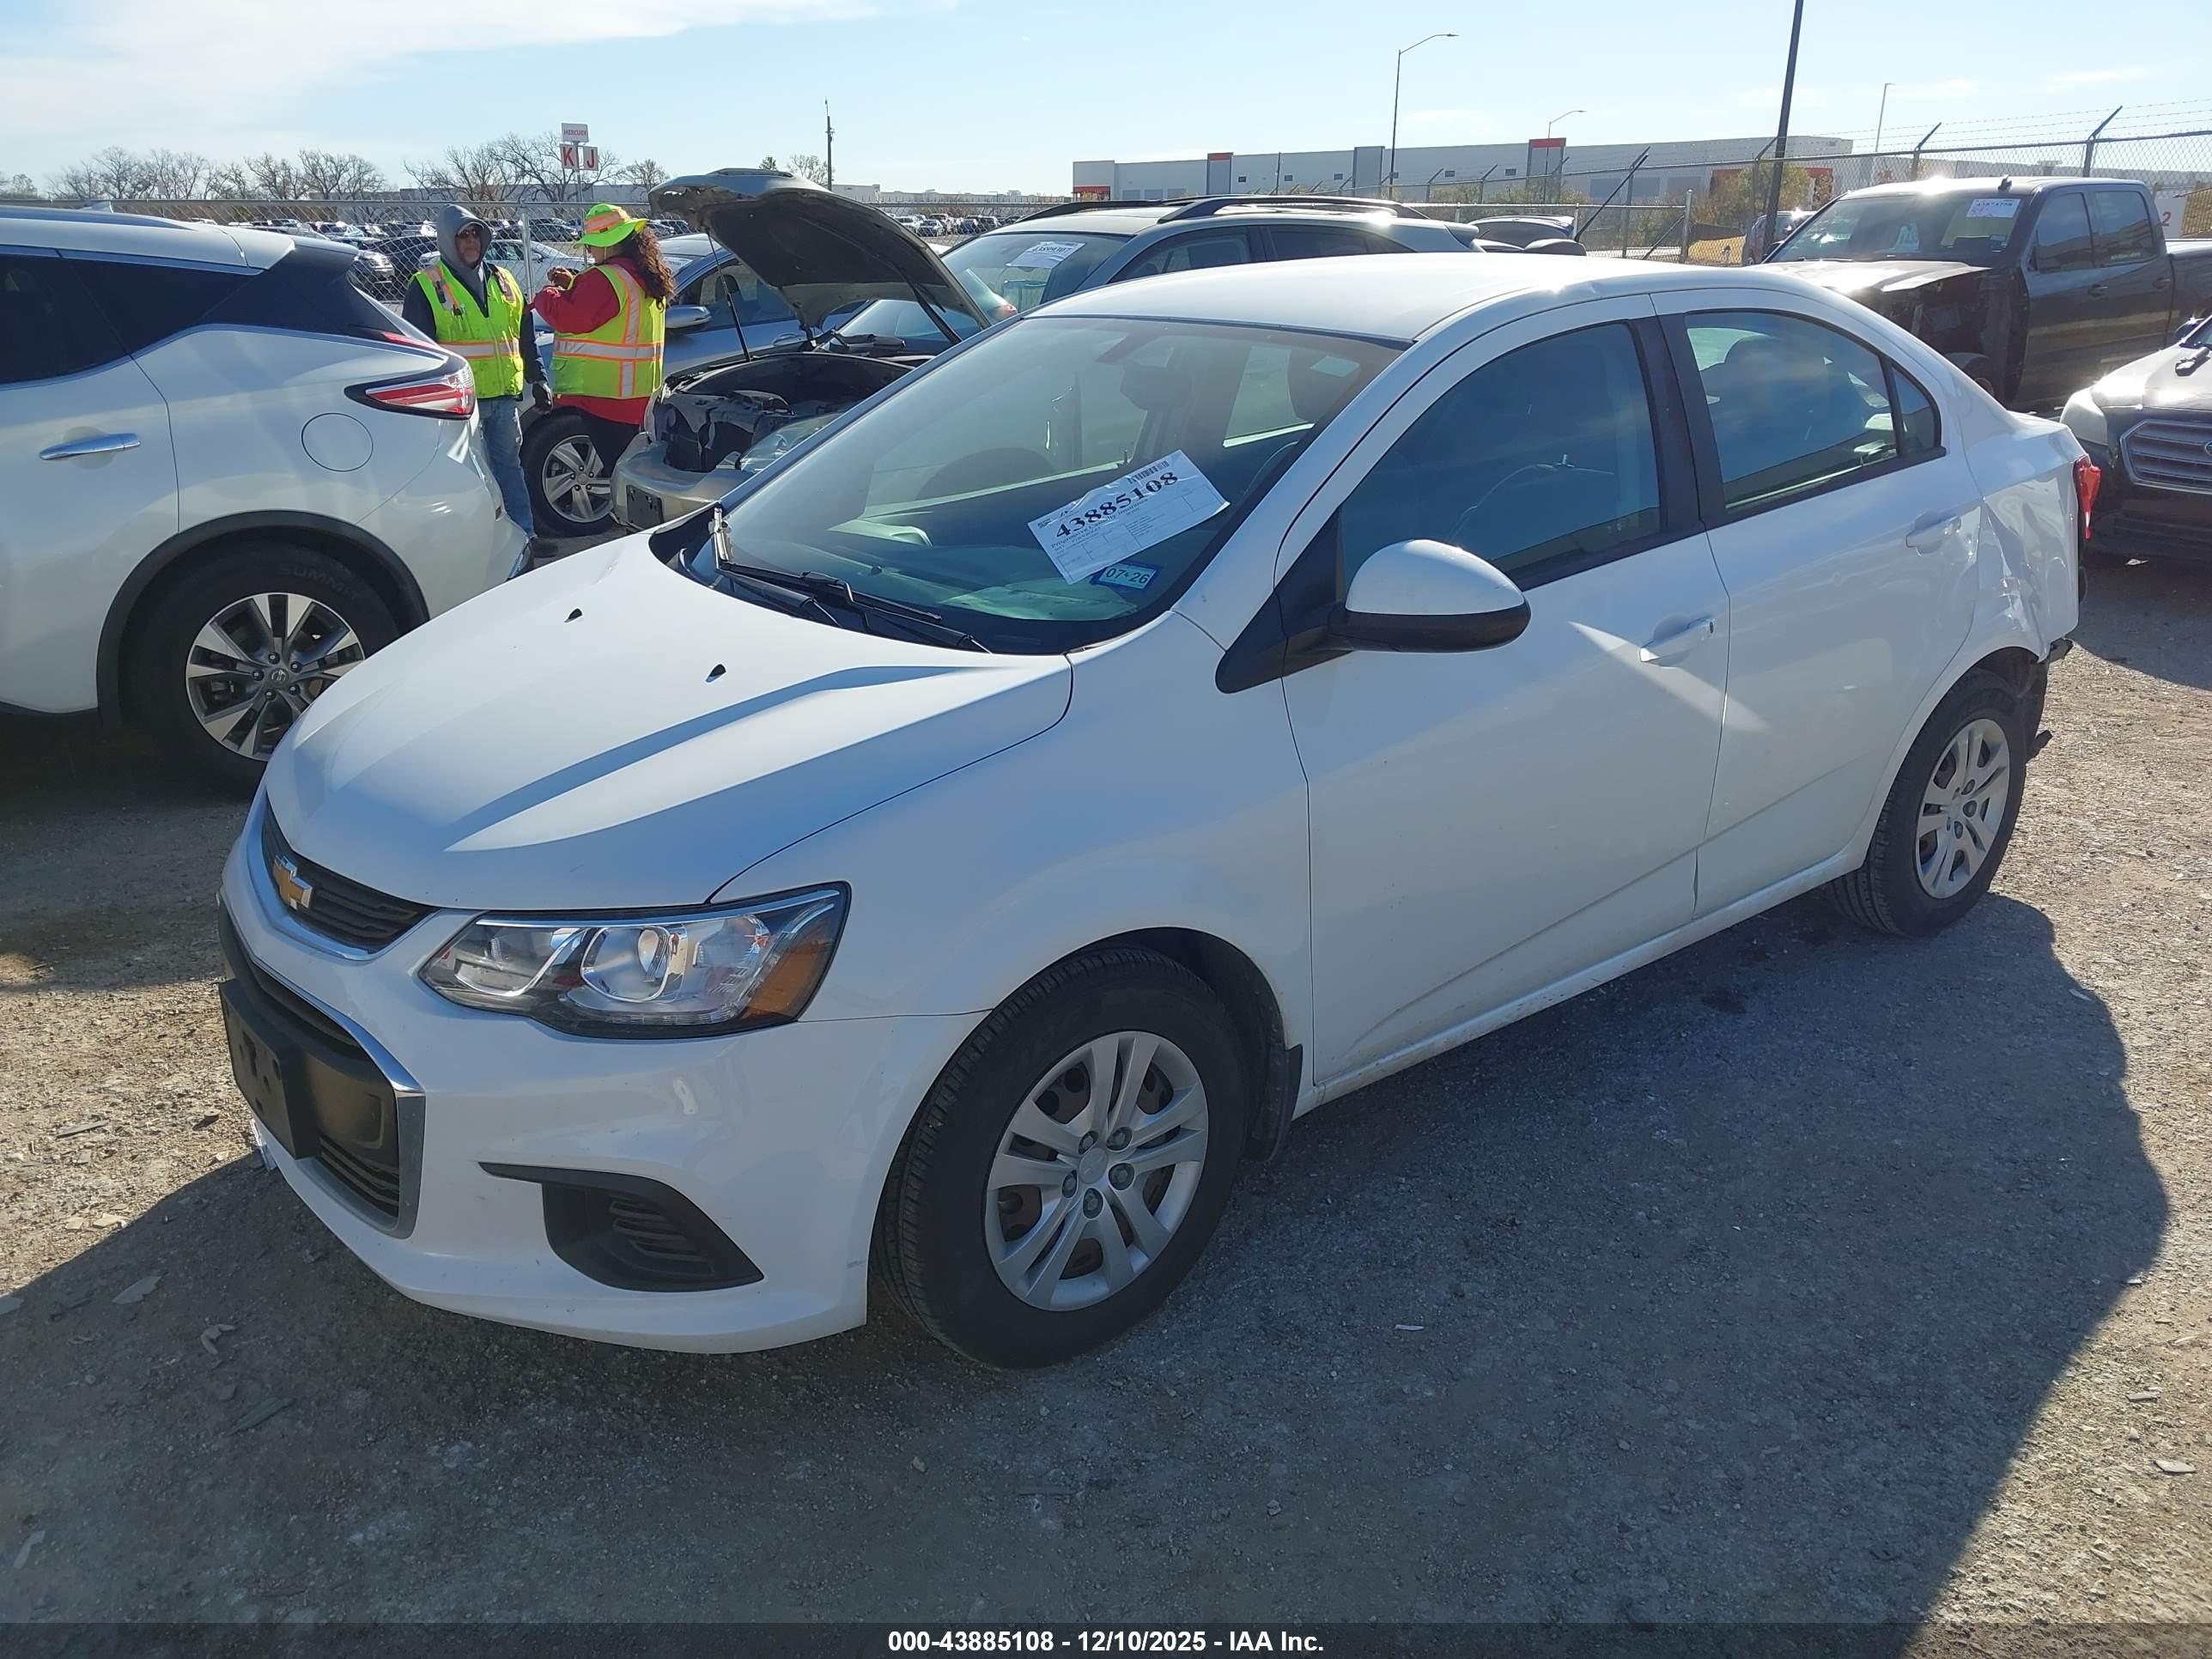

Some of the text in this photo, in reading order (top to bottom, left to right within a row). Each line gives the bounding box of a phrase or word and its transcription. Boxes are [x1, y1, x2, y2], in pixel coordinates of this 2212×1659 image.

[562, 146, 575, 167] K
[586, 149, 595, 168] J
[2162, 211, 2172, 227] 2
[1055, 471, 1178, 538] 43885108
[1128, 572, 1150, 584] 26
